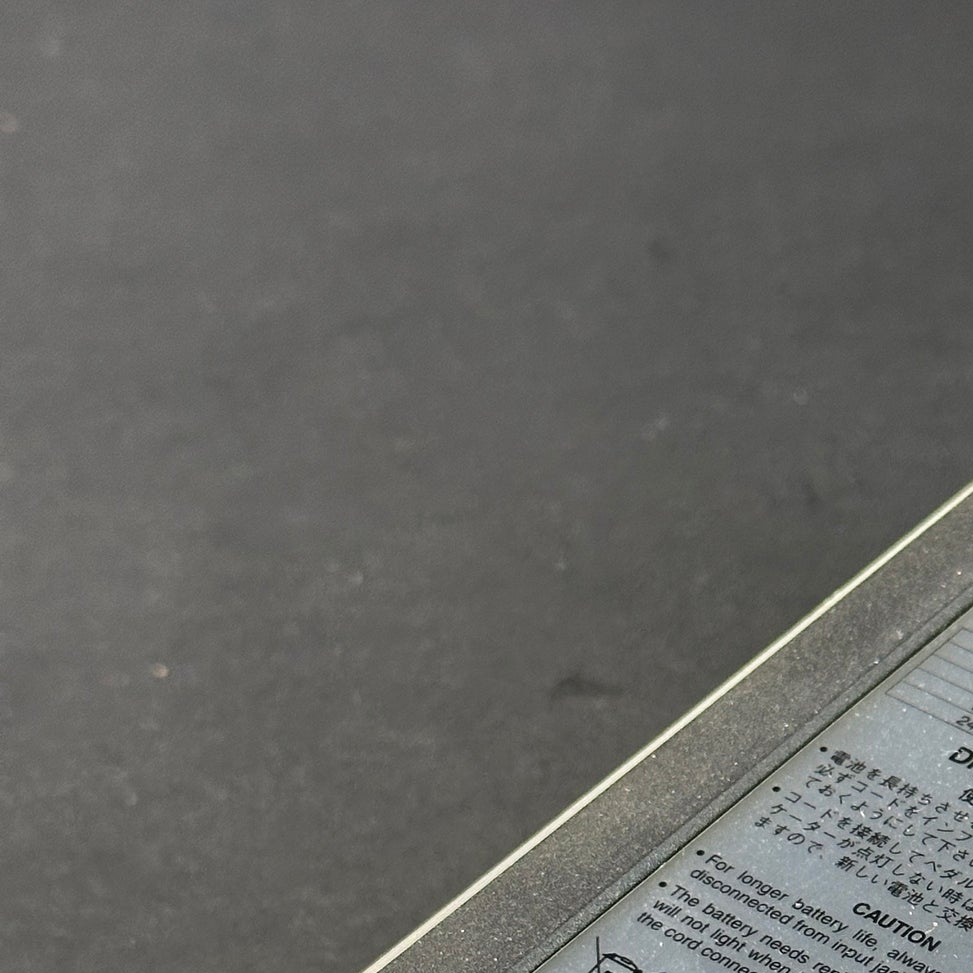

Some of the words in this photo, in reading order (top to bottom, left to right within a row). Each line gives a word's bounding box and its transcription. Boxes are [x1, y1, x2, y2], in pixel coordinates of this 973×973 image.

[636, 911, 664, 931] the
[663, 928, 704, 951] cord
[652, 900, 683, 918] will
[680, 915, 711, 934] not
[709, 928, 747, 953] light
[670, 884, 700, 907] The
[701, 902, 759, 938] battery
[759, 934, 810, 964] needs
[689, 869, 795, 925] disconnected
[792, 919, 830, 945] from
[831, 939, 875, 967] input
[704, 854, 735, 874] For
[736, 870, 790, 901] longer
[791, 898, 849, 934] battery
[852, 928, 878, 952] life,
[852, 902, 942, 952] CAUTION
